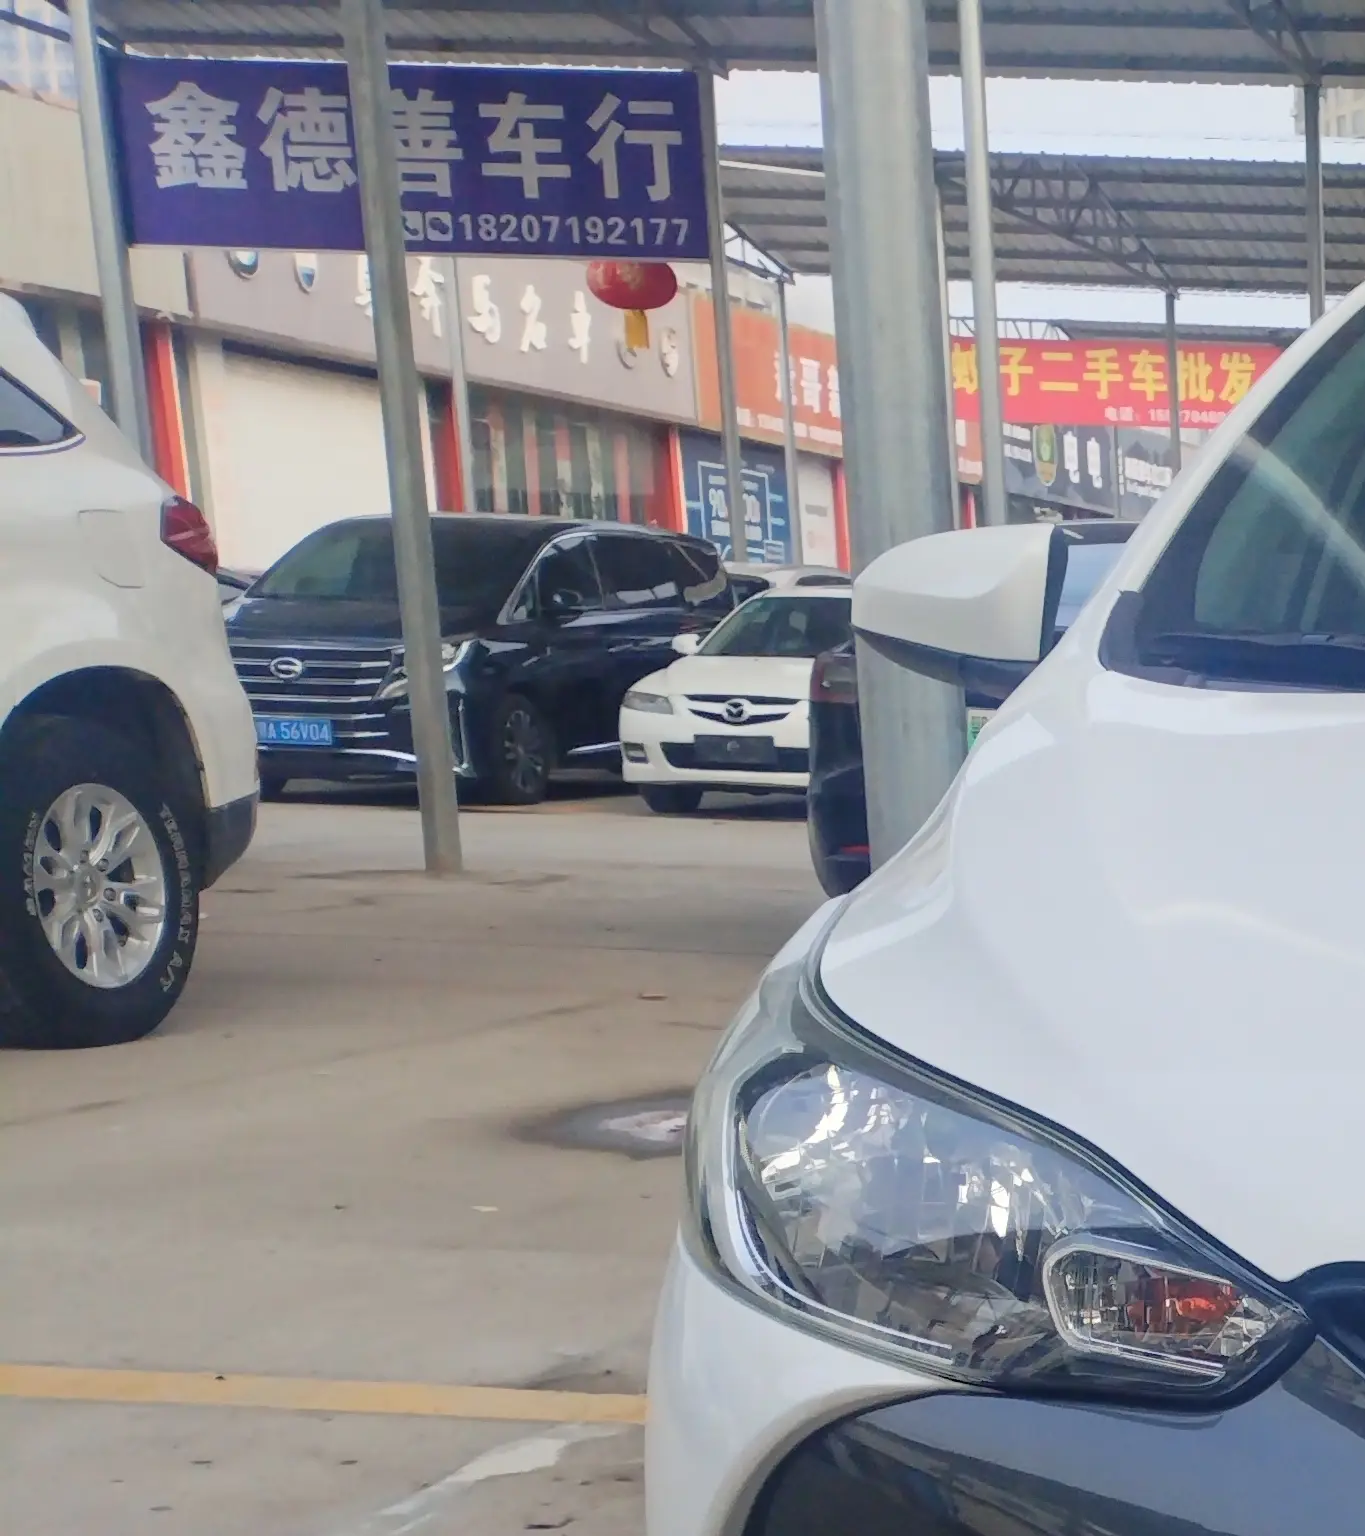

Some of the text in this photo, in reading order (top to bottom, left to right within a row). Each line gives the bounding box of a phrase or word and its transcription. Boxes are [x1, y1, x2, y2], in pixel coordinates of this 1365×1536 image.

[145, 81, 683, 202] 鑫德善车行
[457, 213, 690, 246] 18207192177
